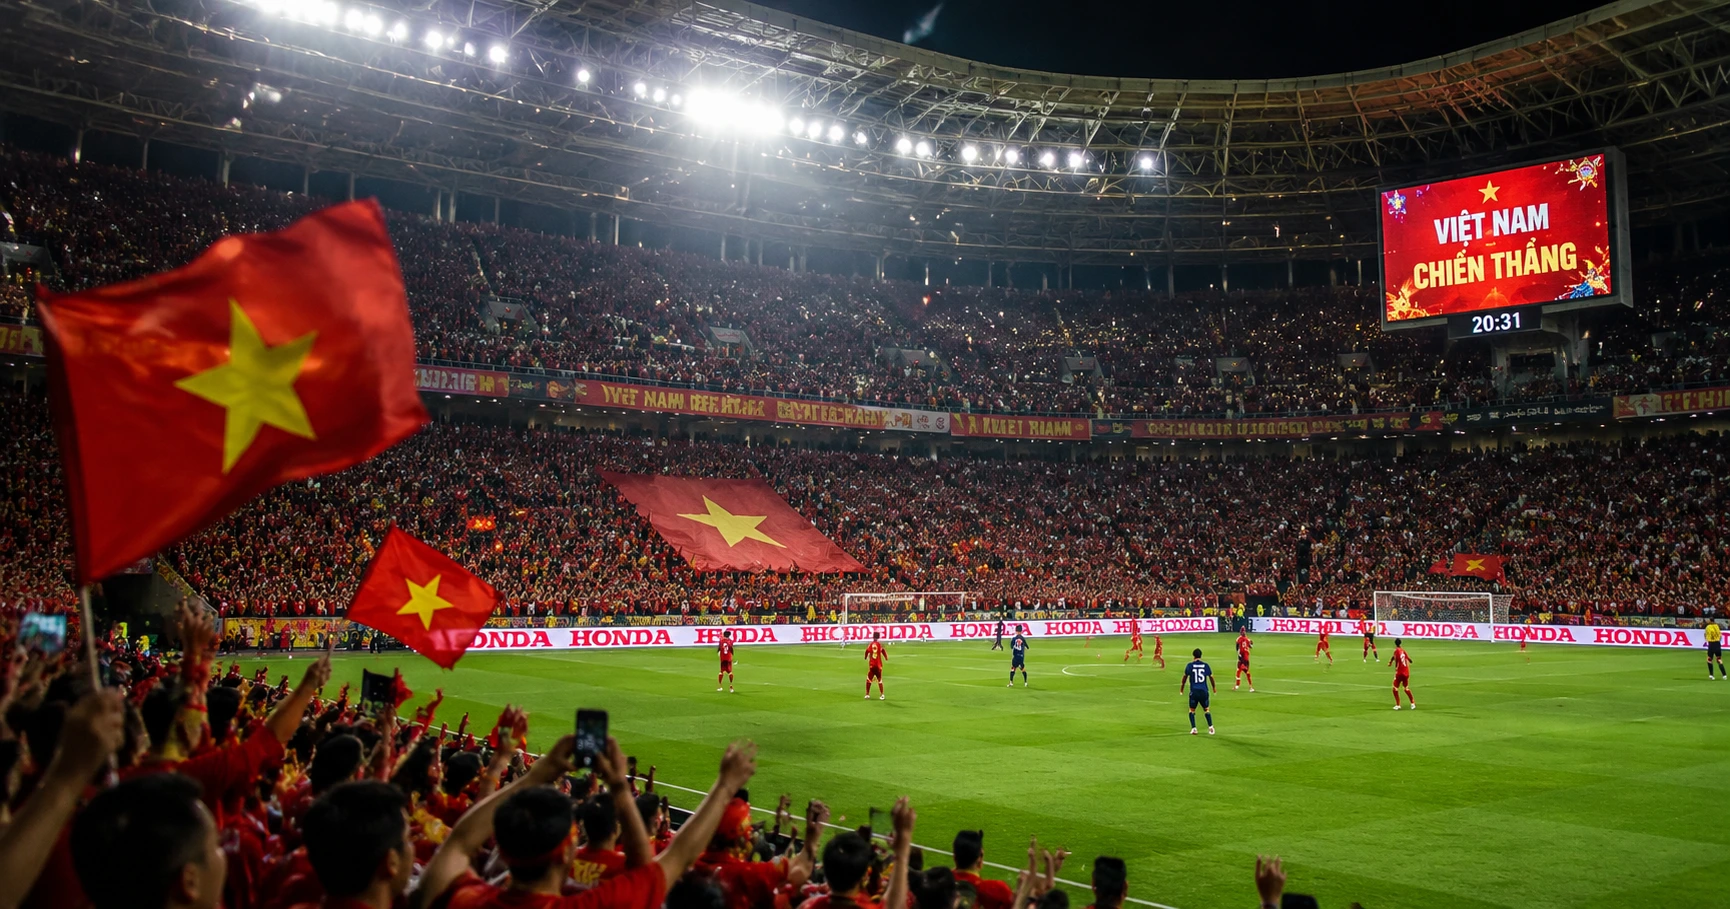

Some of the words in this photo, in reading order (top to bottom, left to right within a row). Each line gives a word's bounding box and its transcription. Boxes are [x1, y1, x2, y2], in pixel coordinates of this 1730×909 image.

[1433, 209, 1486, 247] VIỆT
[1492, 203, 1550, 236] NAM
[1472, 312, 1520, 333] 20:31
[469, 631, 553, 648] ONDA
[569, 629, 673, 646] HONDA
[1594, 628, 1693, 646] HONDA
[1192, 668, 1205, 683] 15
